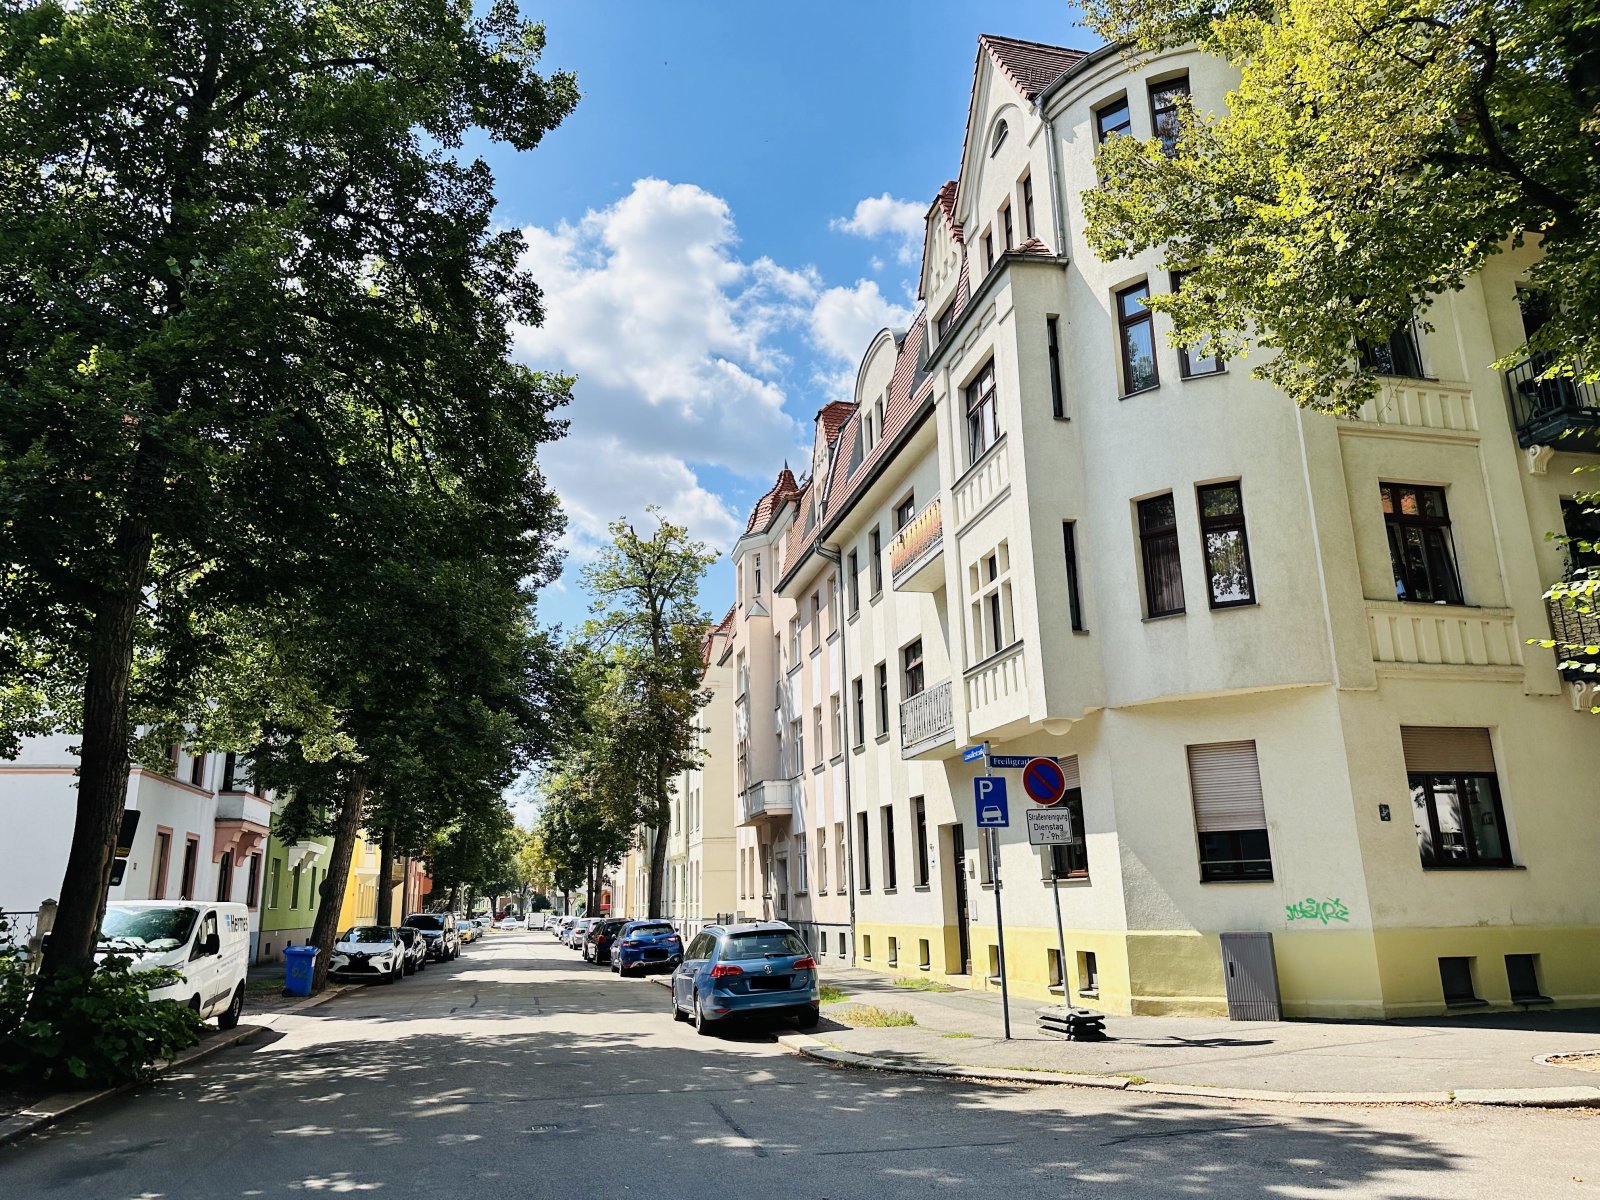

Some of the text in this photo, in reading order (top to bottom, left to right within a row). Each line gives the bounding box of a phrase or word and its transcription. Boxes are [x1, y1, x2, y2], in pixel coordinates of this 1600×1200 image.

[979, 780, 993, 800] P
[1033, 823, 1064, 832] Dienstag
[1040, 832, 1045, 841] 7
